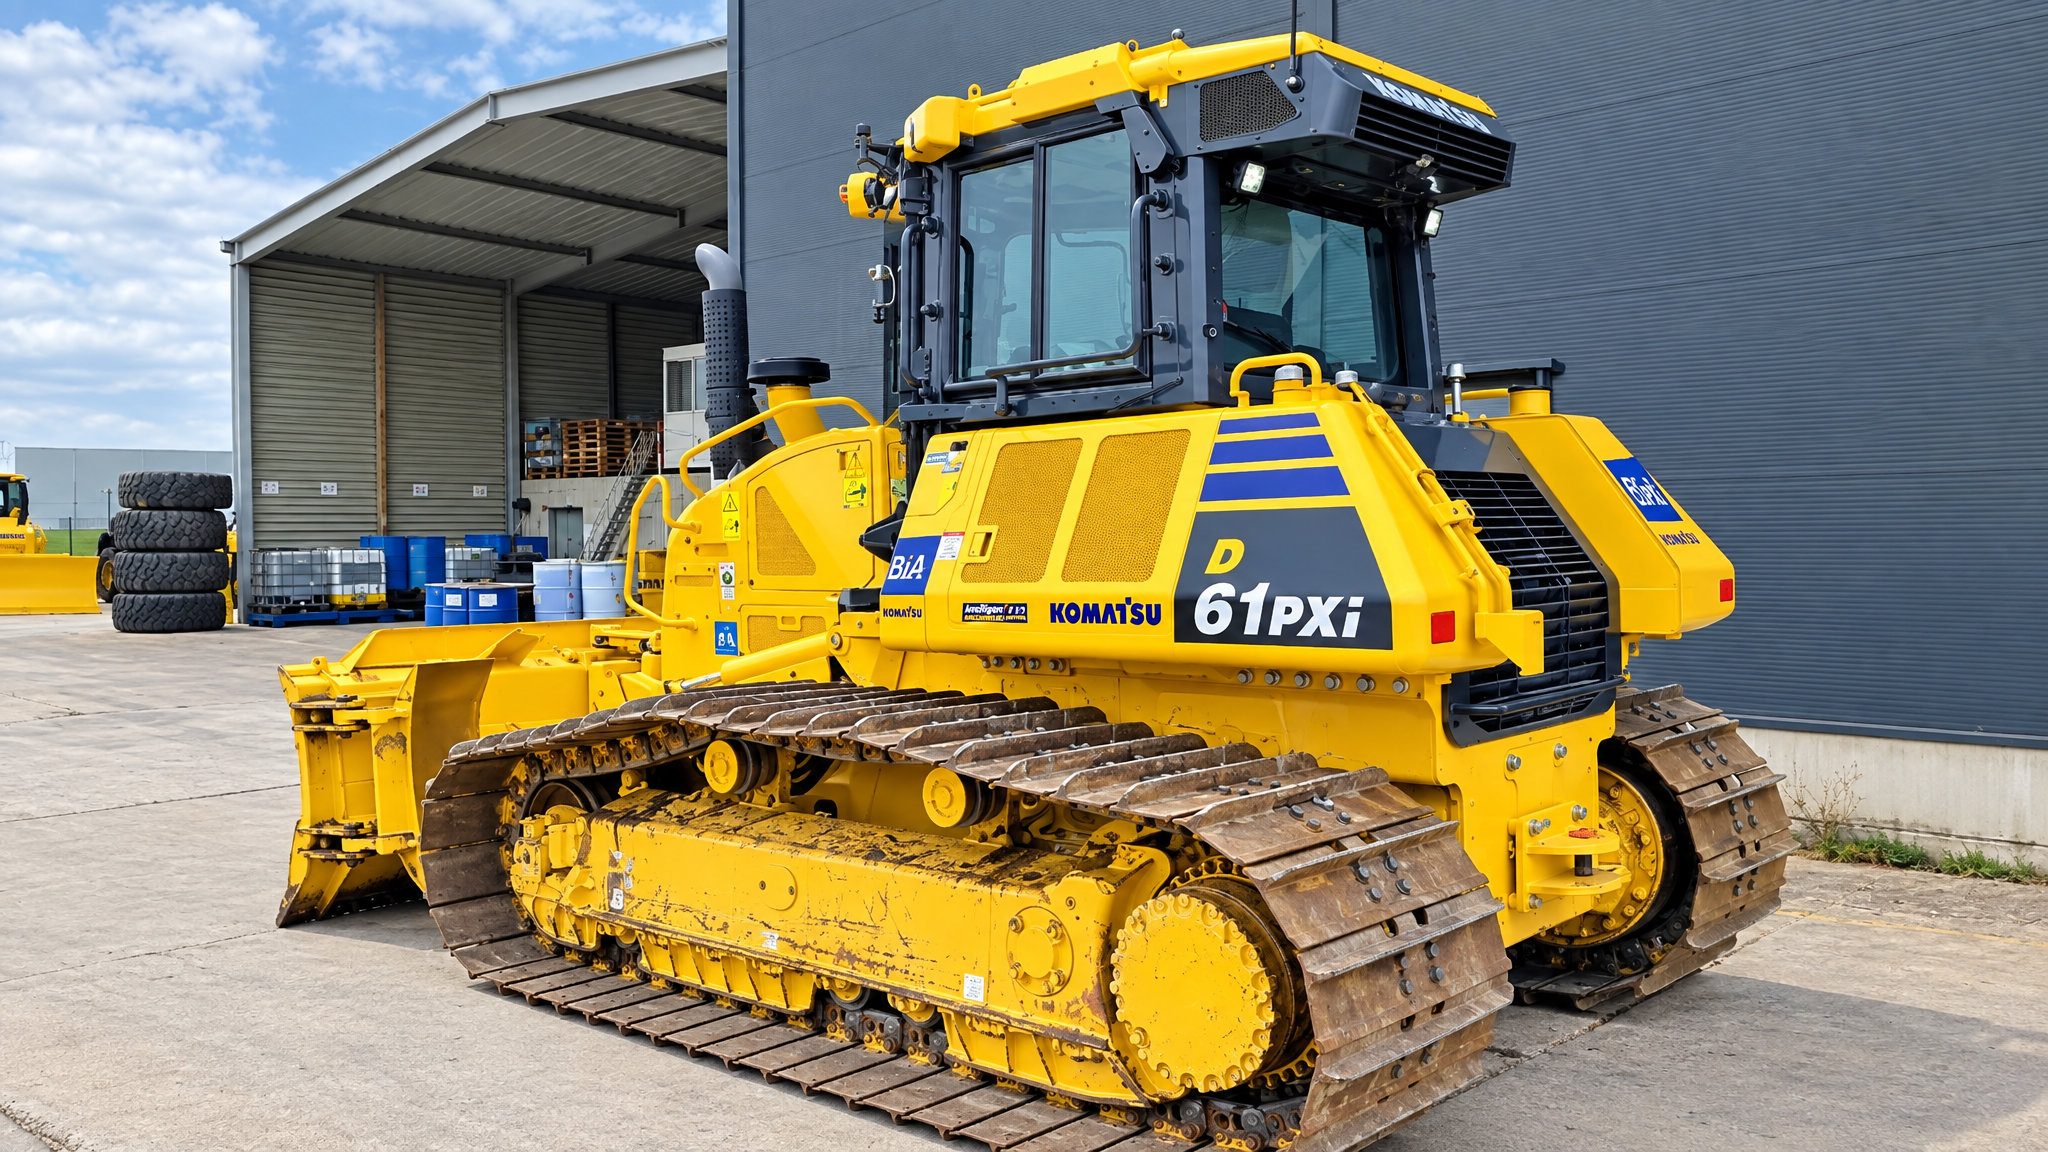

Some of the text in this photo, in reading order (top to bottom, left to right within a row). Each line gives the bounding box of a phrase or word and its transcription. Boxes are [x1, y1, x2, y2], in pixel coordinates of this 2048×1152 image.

[1362, 71, 1493, 135] KOMATSU
[887, 554, 925, 580] BiA
[1204, 538, 1245, 575] D
[882, 606, 922, 618] KOMATSU
[1050, 596, 1162, 626] KOMATSU
[1194, 582, 1365, 638] 61PXi
